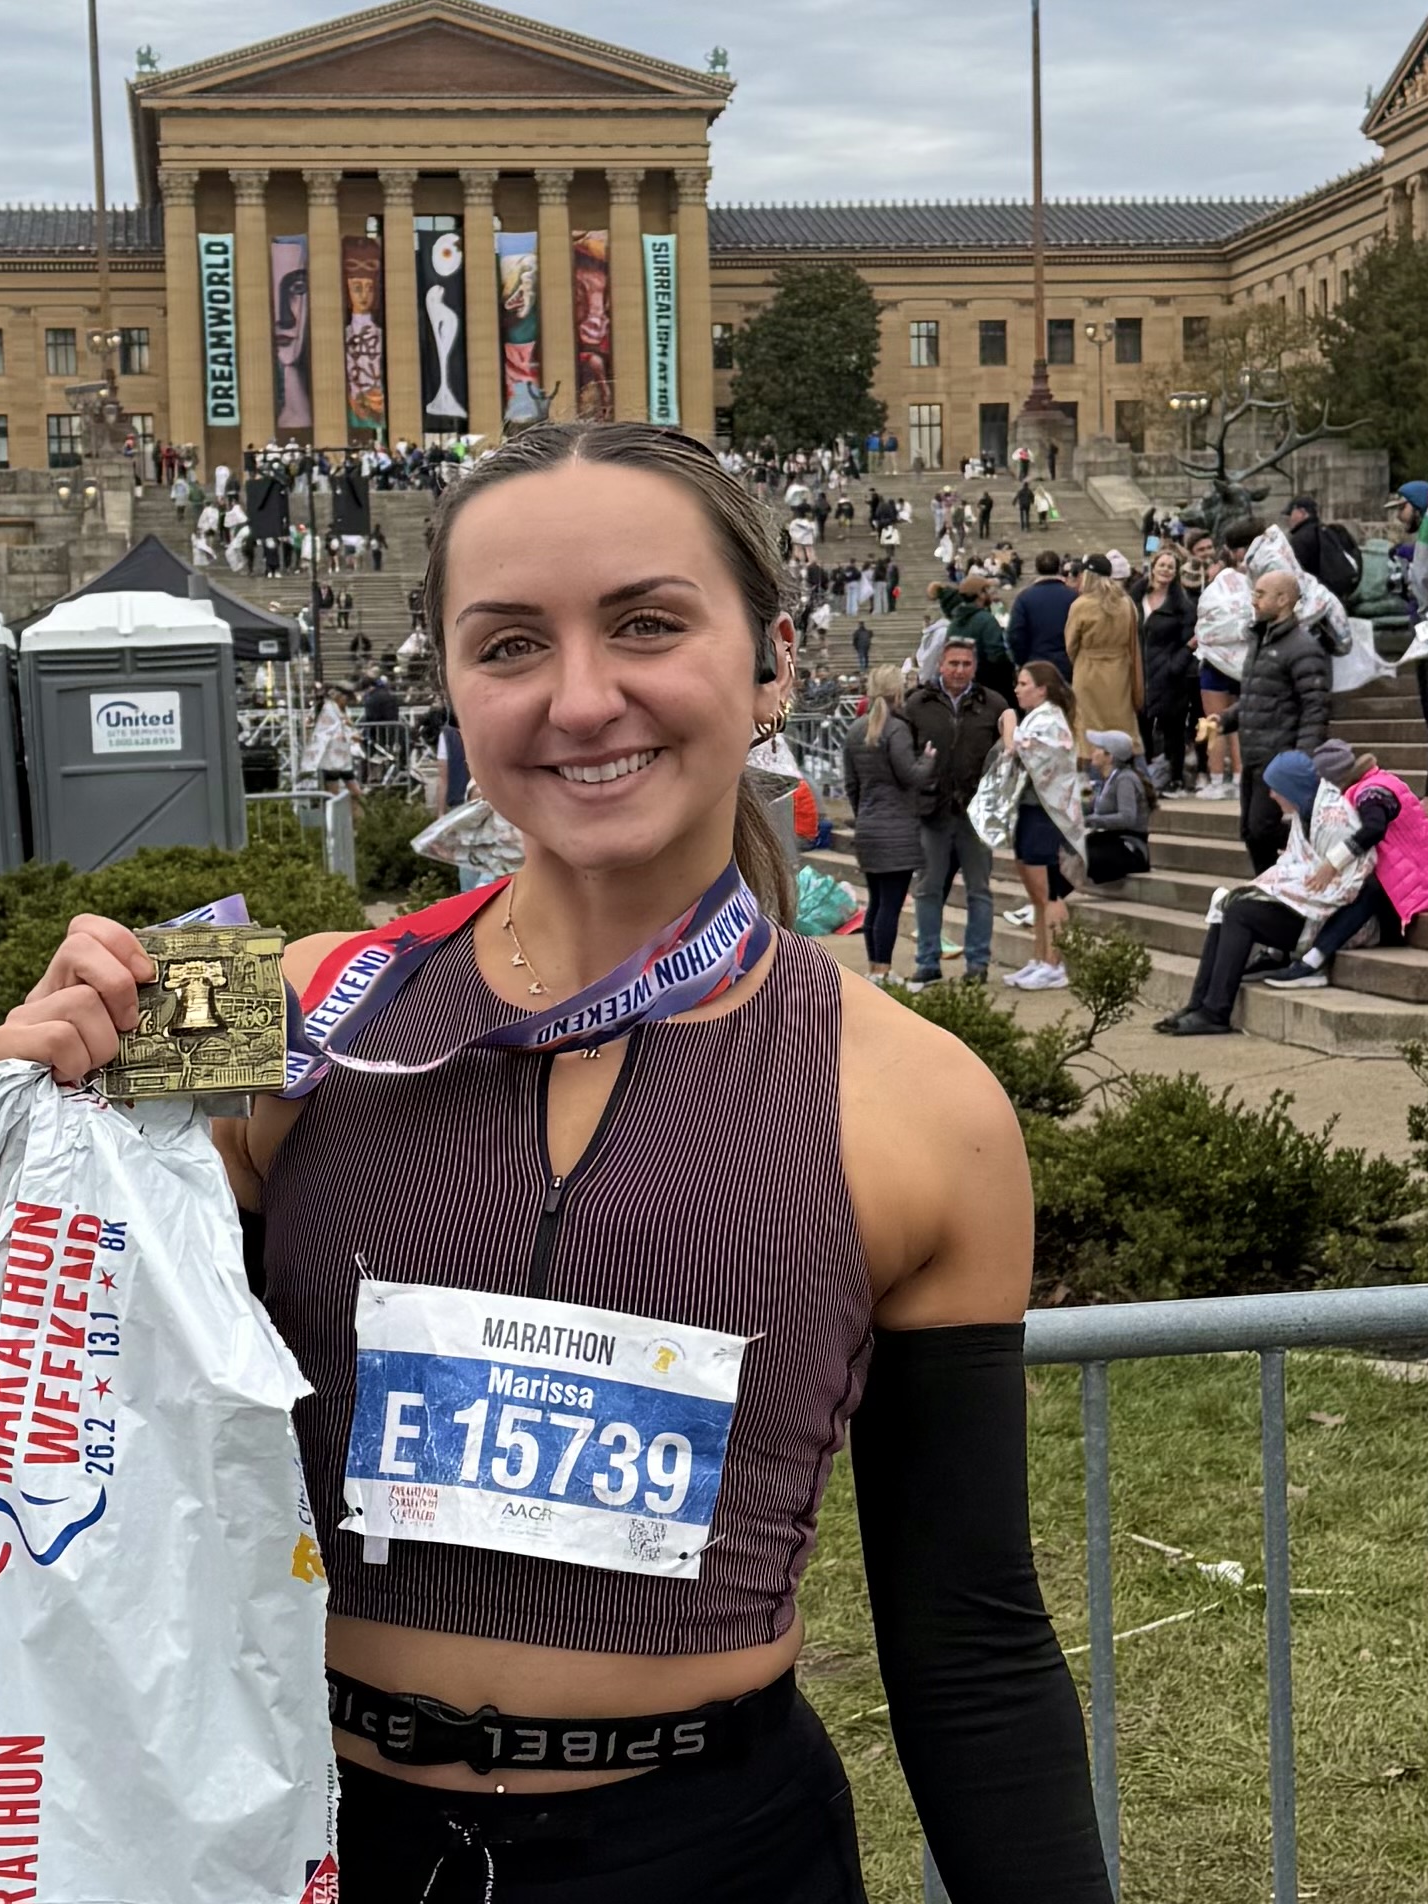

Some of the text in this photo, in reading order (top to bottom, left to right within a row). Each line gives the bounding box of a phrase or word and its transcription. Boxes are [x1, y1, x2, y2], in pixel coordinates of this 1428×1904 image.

[204, 241, 235, 418] DREAMWORLD
[652, 242, 672, 358] SURREALISM
[106, 709, 174, 728] United
[305, 946, 390, 1041] WEEKEND
[536, 894, 752, 1045] MARATHON WEEKEND
[24, 1213, 102, 1464] WEEKEND
[84, 1218, 128, 1476] 26.2 13.1 8K
[482, 1316, 616, 1367] MARATHON
[487, 1366, 595, 1410] Marissa
[378, 1390, 425, 1475] E
[453, 1398, 693, 1514] 15739
[483, 1720, 707, 1763] SPIBEL
